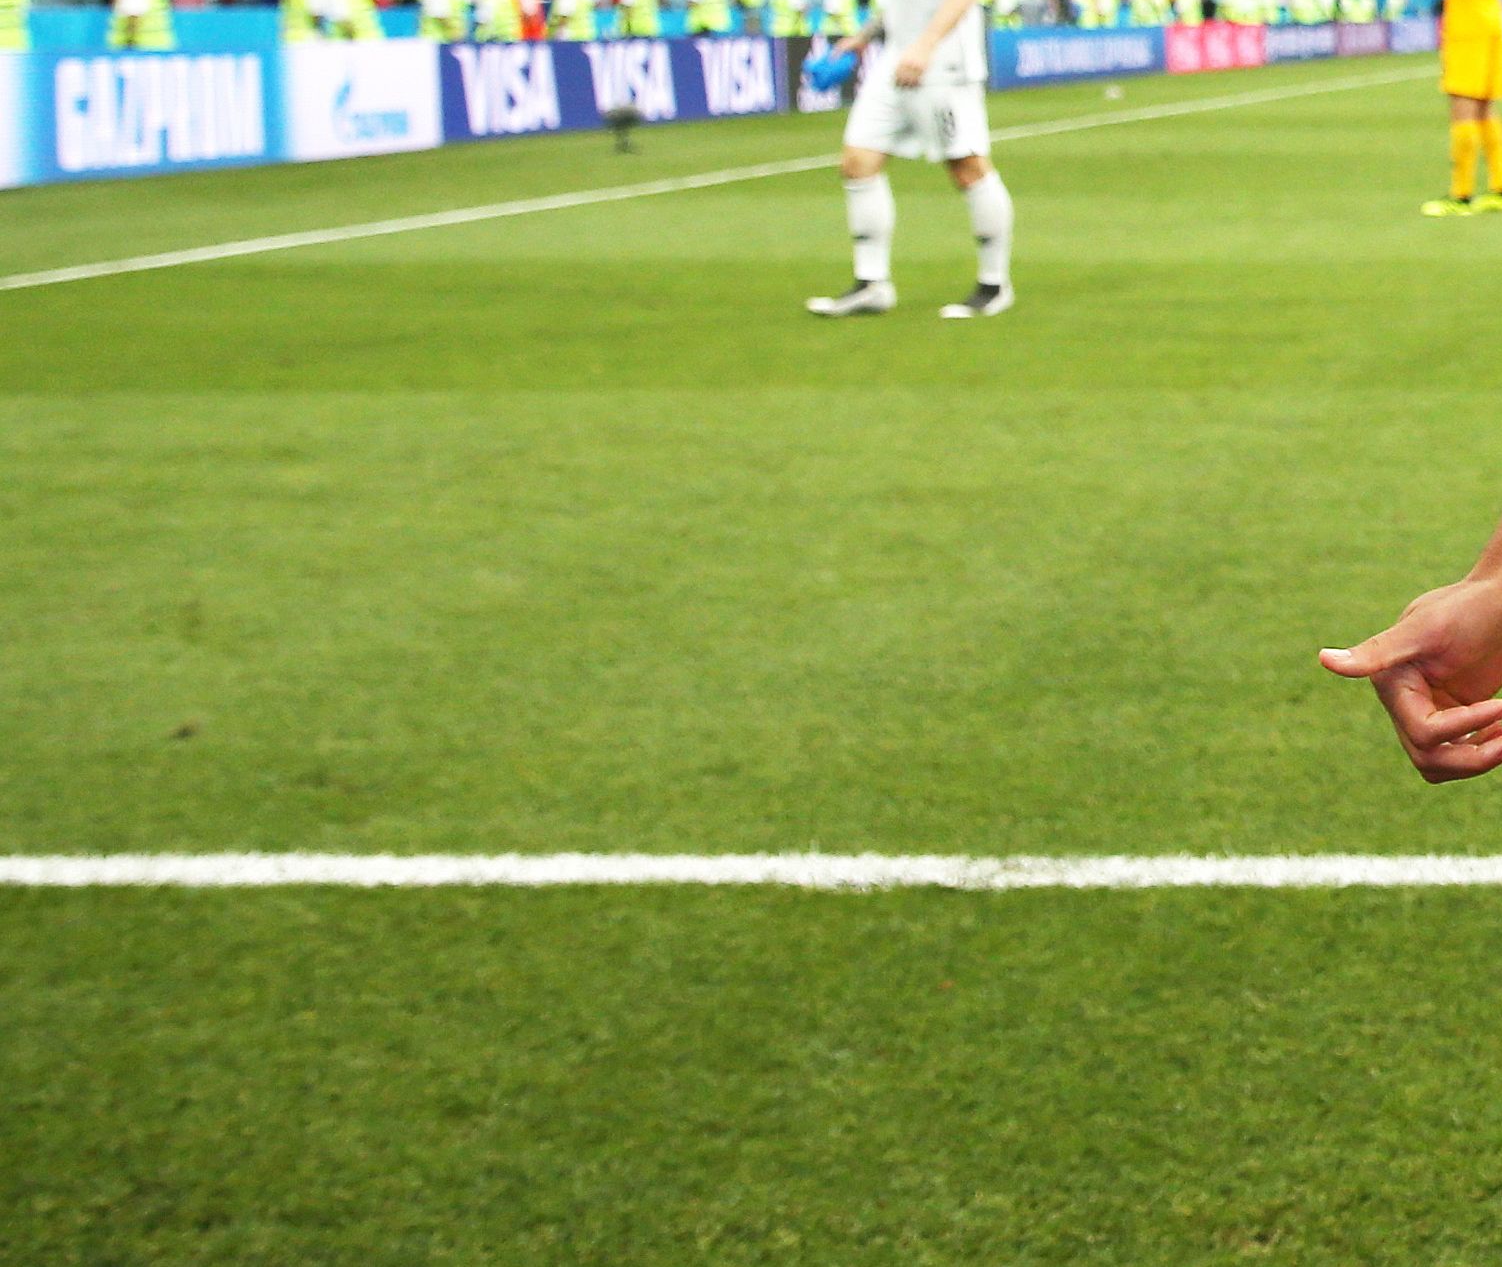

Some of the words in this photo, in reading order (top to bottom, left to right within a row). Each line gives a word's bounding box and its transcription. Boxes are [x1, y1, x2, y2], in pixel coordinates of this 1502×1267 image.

[55, 54, 263, 170] GAZPROM
[452, 42, 561, 136] VISA
[582, 39, 677, 121] VISA
[694, 35, 776, 116] VISA
